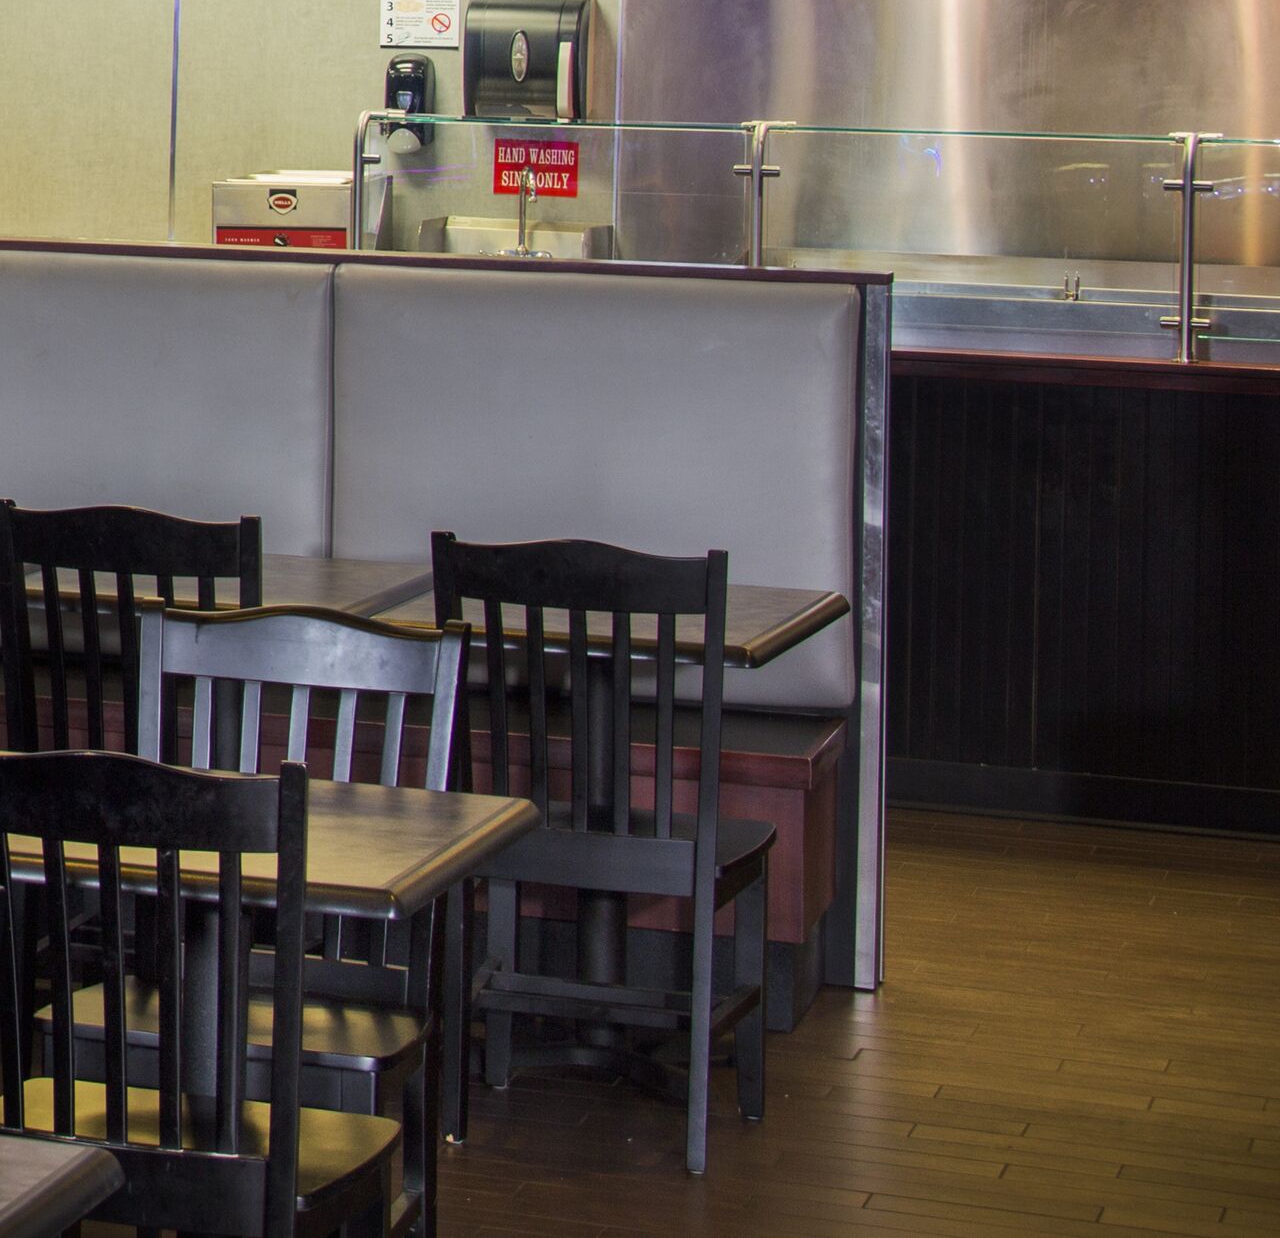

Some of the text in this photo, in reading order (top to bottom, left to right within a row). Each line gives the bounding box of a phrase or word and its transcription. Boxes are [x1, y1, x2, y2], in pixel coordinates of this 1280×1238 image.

[386, 1, 394, 12] 3
[386, 17, 394, 27] 4
[386, 33, 394, 44] 5
[497, 145, 576, 166] HAND WASHING
[501, 170, 571, 190] SIN ONLY
